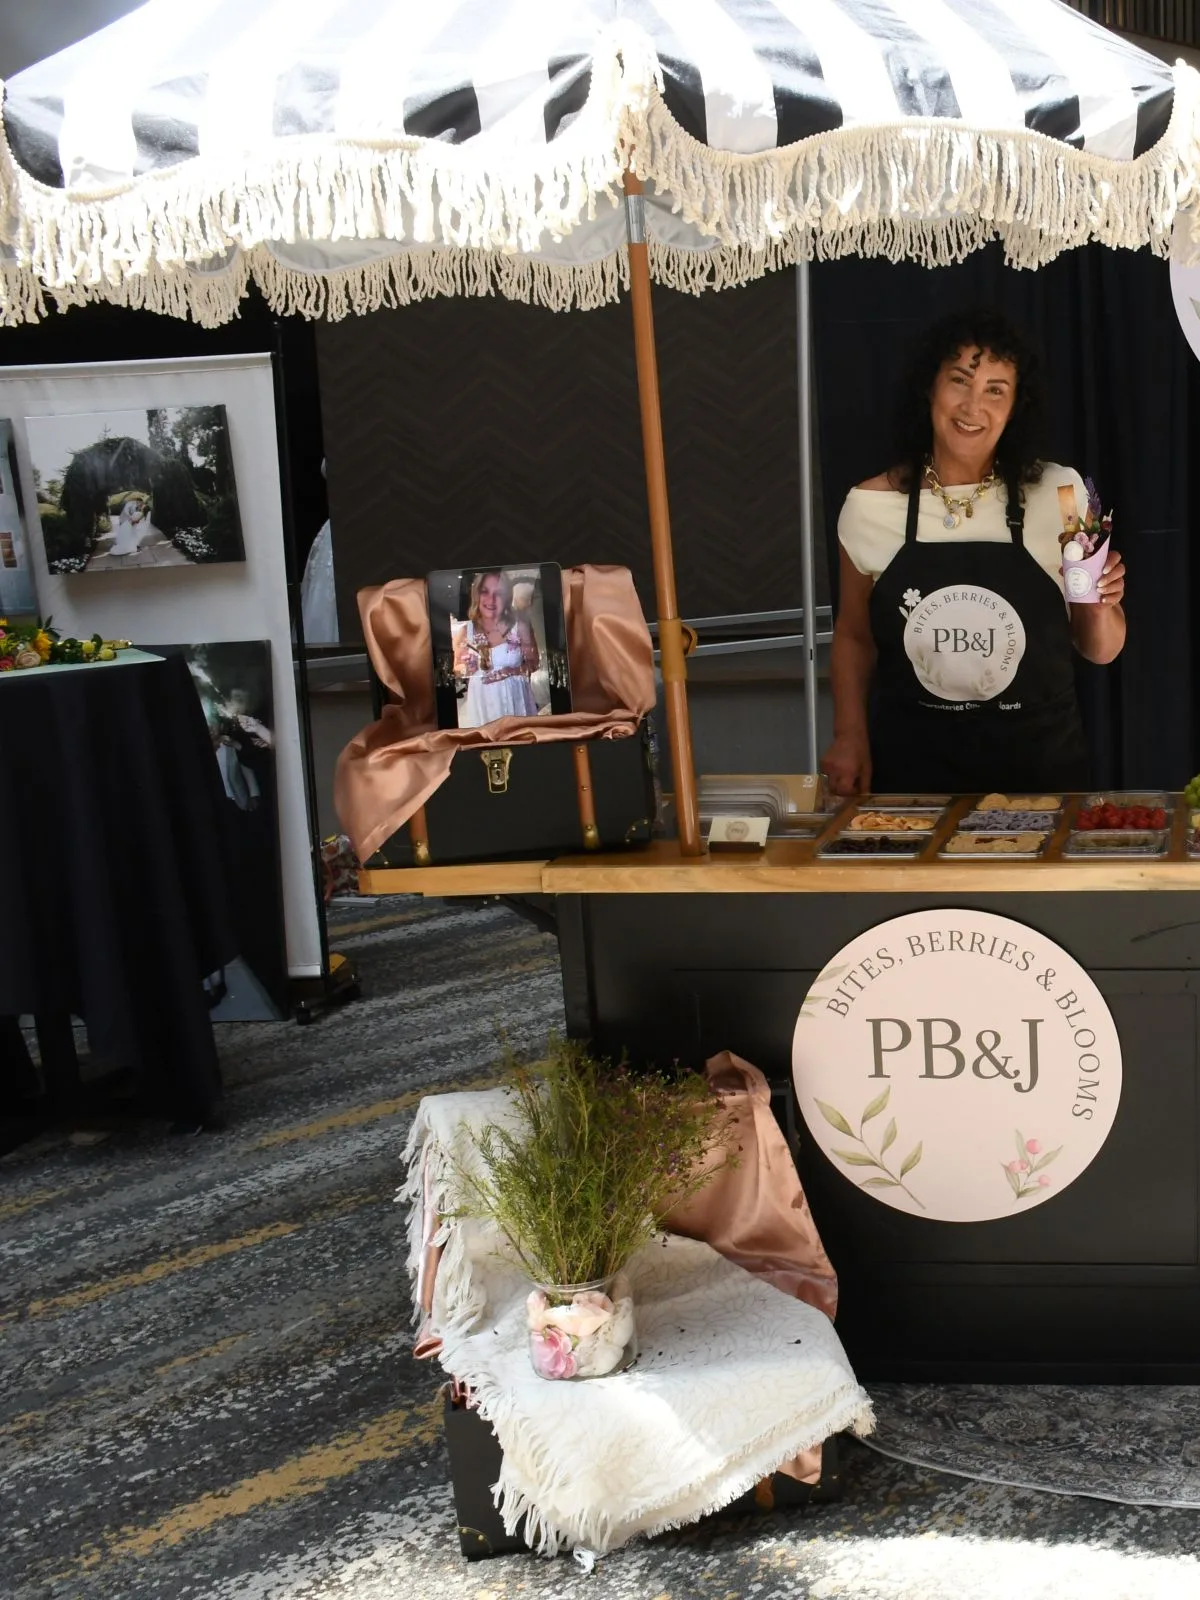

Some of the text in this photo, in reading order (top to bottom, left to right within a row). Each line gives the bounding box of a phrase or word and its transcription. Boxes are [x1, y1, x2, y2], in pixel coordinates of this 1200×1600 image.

[914, 600, 942, 634] BITES,
[943, 591, 998, 611] BERRIES
[1000, 623, 1017, 673] BLOOMS
[932, 628, 996, 658] PB&J
[826, 930, 1101, 1121] BITES, BERRIES & BLOOMS
[865, 1018, 1045, 1093] PB&J
